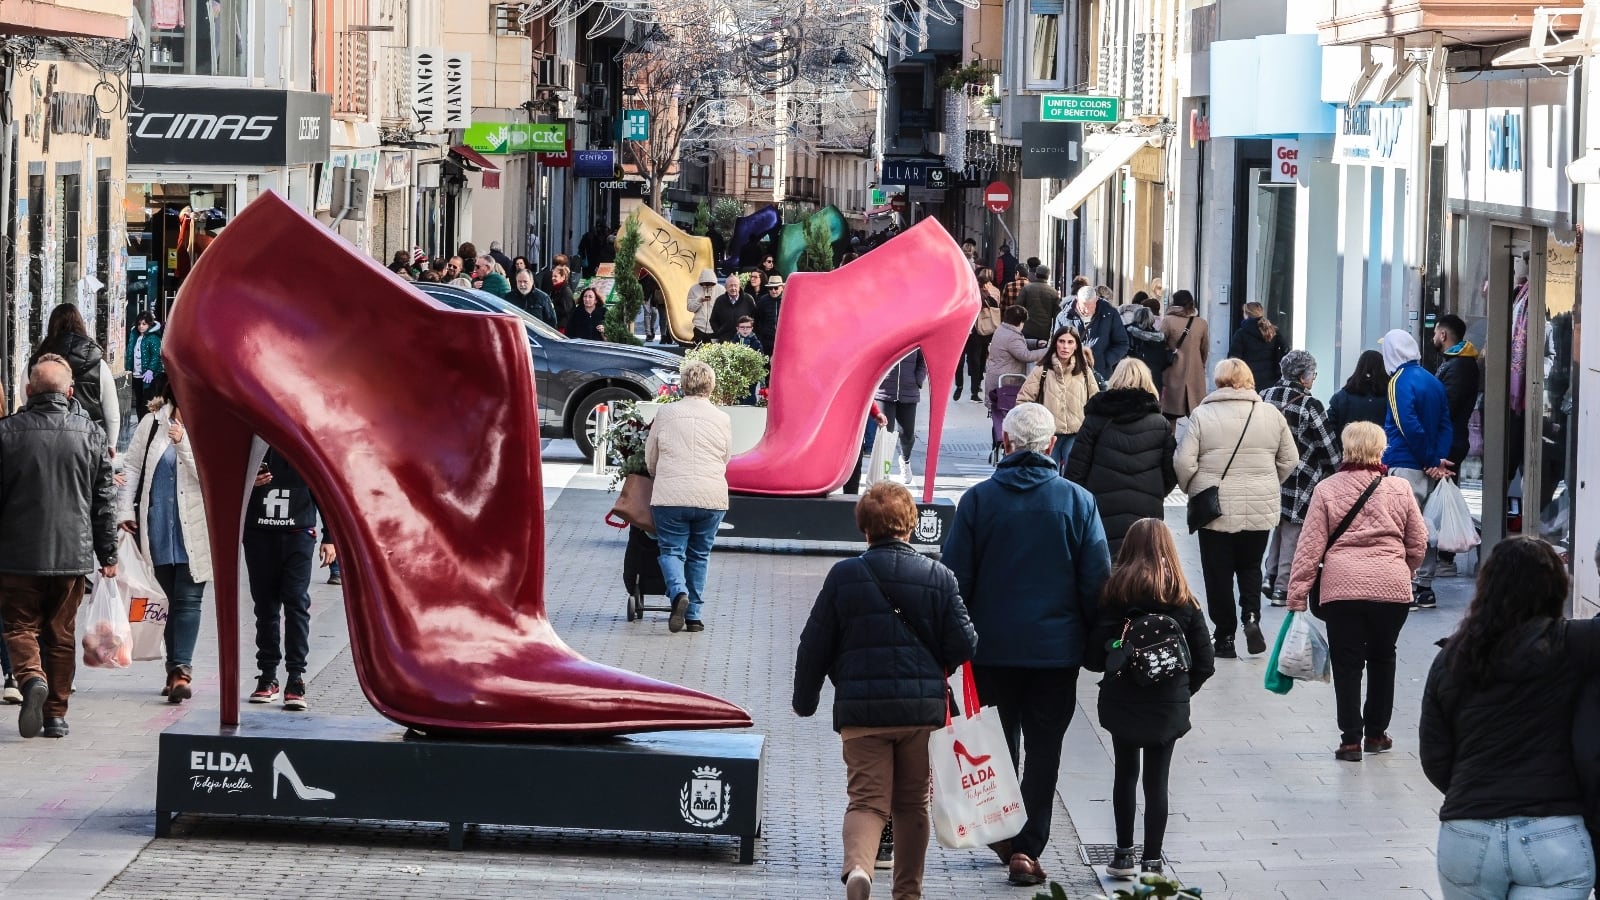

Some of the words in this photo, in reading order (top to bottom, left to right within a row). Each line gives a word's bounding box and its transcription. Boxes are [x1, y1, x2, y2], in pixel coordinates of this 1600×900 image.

[417, 53, 433, 123] MANGO
[447, 58, 462, 122] MANGO
[1047, 99, 1078, 108] UNITED
[1079, 100, 1112, 109] COLORS
[1050, 108, 1063, 116] OF
[128, 113, 278, 141] CIMAS
[532, 131, 563, 143] CRC
[888, 166, 919, 180] LLAR
[599, 180, 627, 189] outlet
[263, 488, 291, 518] fi
[257, 517, 296, 526] network
[190, 750, 253, 773] ELDA
[189, 775, 201, 791] Te
[201, 776, 221, 793] deja
[961, 765, 996, 790] ELDA
